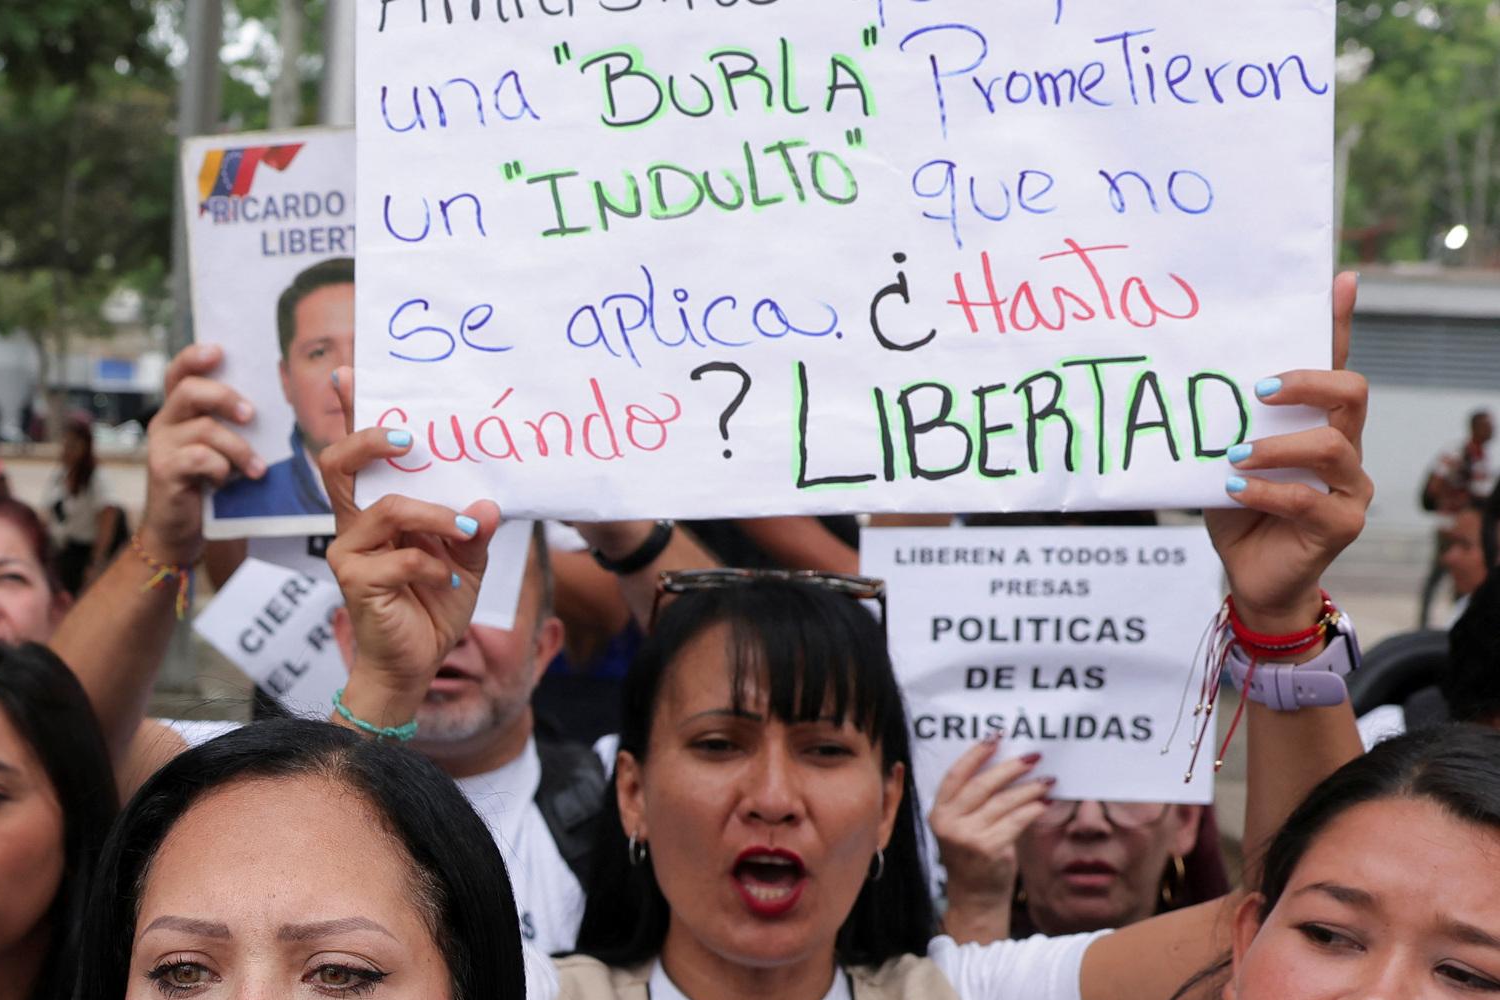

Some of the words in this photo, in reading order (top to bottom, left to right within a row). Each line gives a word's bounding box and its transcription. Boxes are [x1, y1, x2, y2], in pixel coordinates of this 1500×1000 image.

[381, 71, 541, 132] una
[212, 190, 345, 223] RICARDO
[384, 193, 486, 242] un
[913, 158, 1054, 249] que
[1100, 168, 1213, 214] no
[796, 356, 1248, 489] LIBERTAD
[894, 547, 1005, 565] LIBEREN
[1015, 548, 1031, 565] A
[1043, 547, 1128, 565] TODOS
[1138, 548, 1187, 566] LOS
[990, 579, 1091, 597] PRESAS
[931, 616, 1147, 643] POLITICAS
[965, 667, 1015, 690] DE
[1031, 667, 1106, 690] LAS
